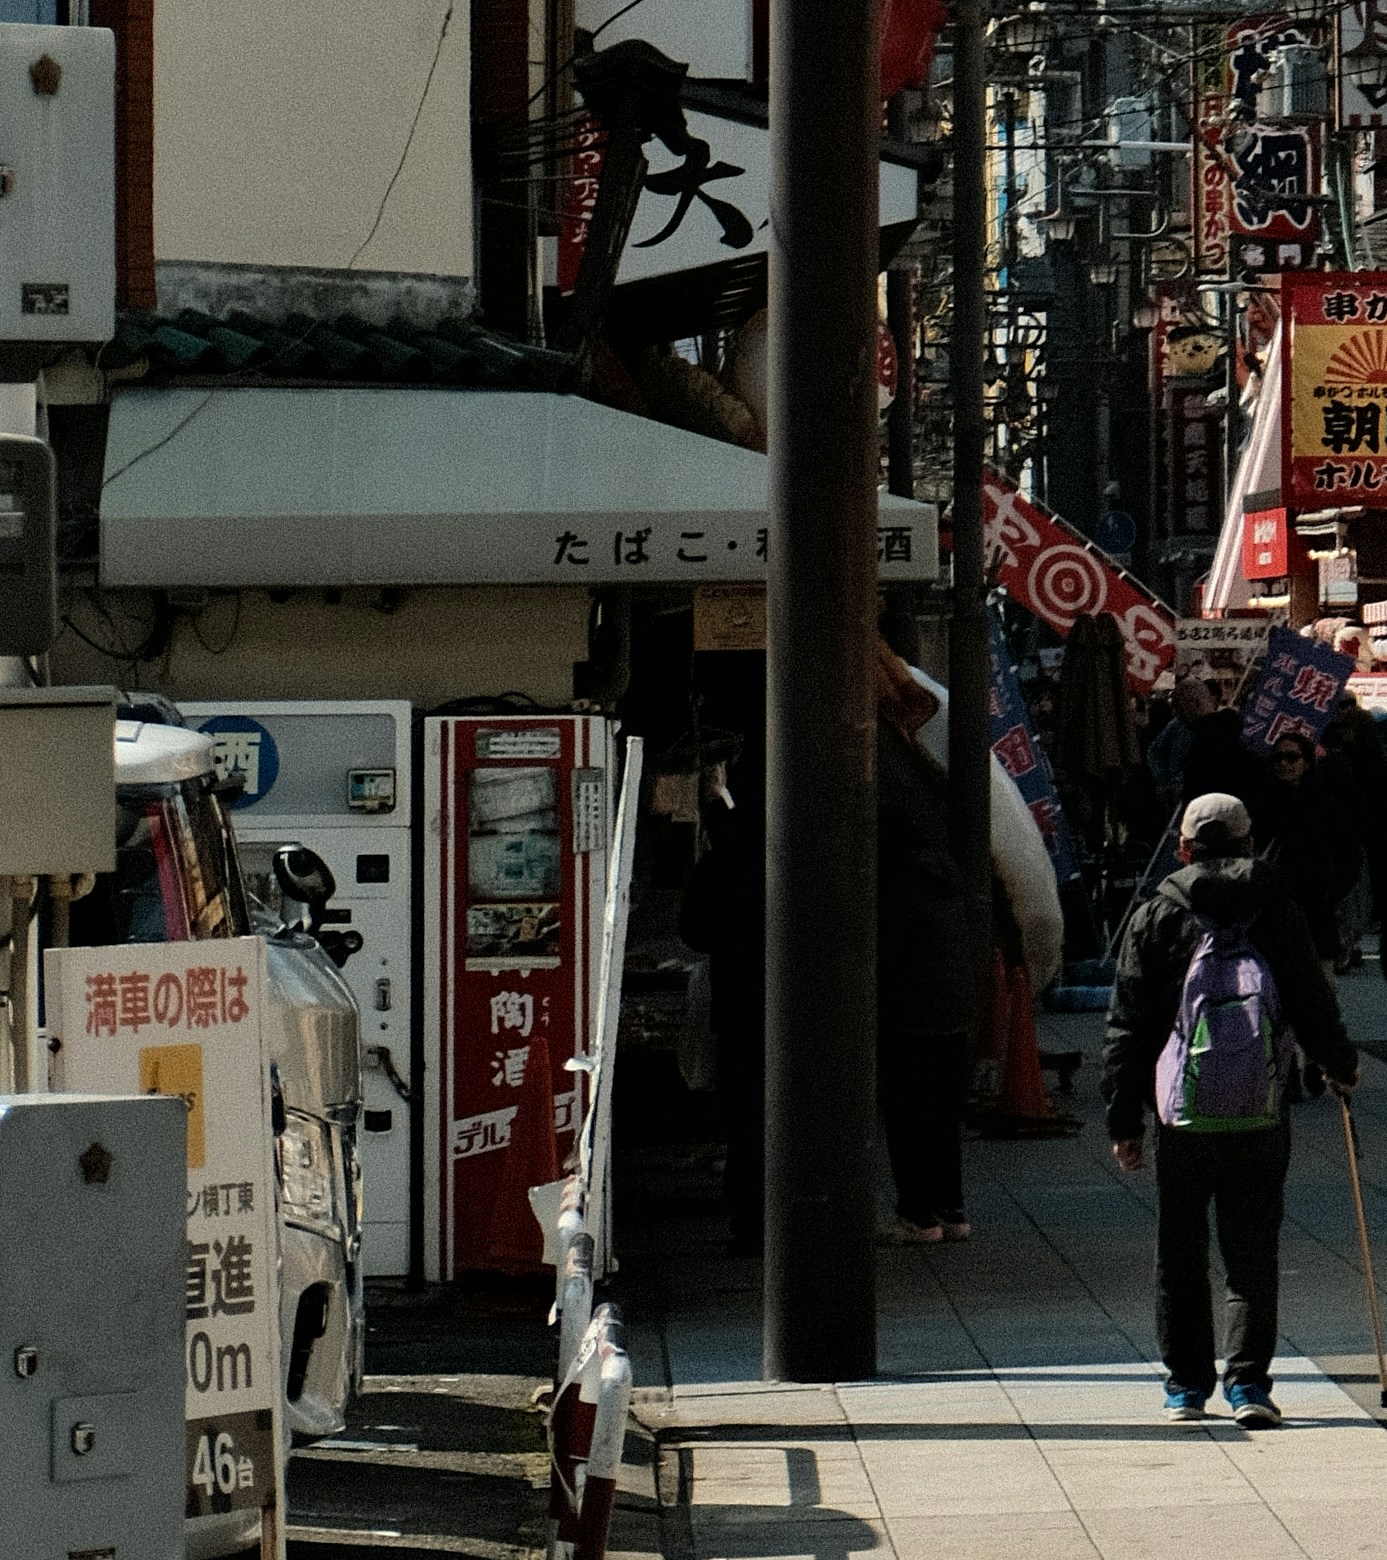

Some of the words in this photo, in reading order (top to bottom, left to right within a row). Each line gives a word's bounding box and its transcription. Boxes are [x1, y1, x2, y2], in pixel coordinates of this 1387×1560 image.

[85, 967, 251, 1037] 満車の際は
[192, 1432, 254, 1494] 46台
